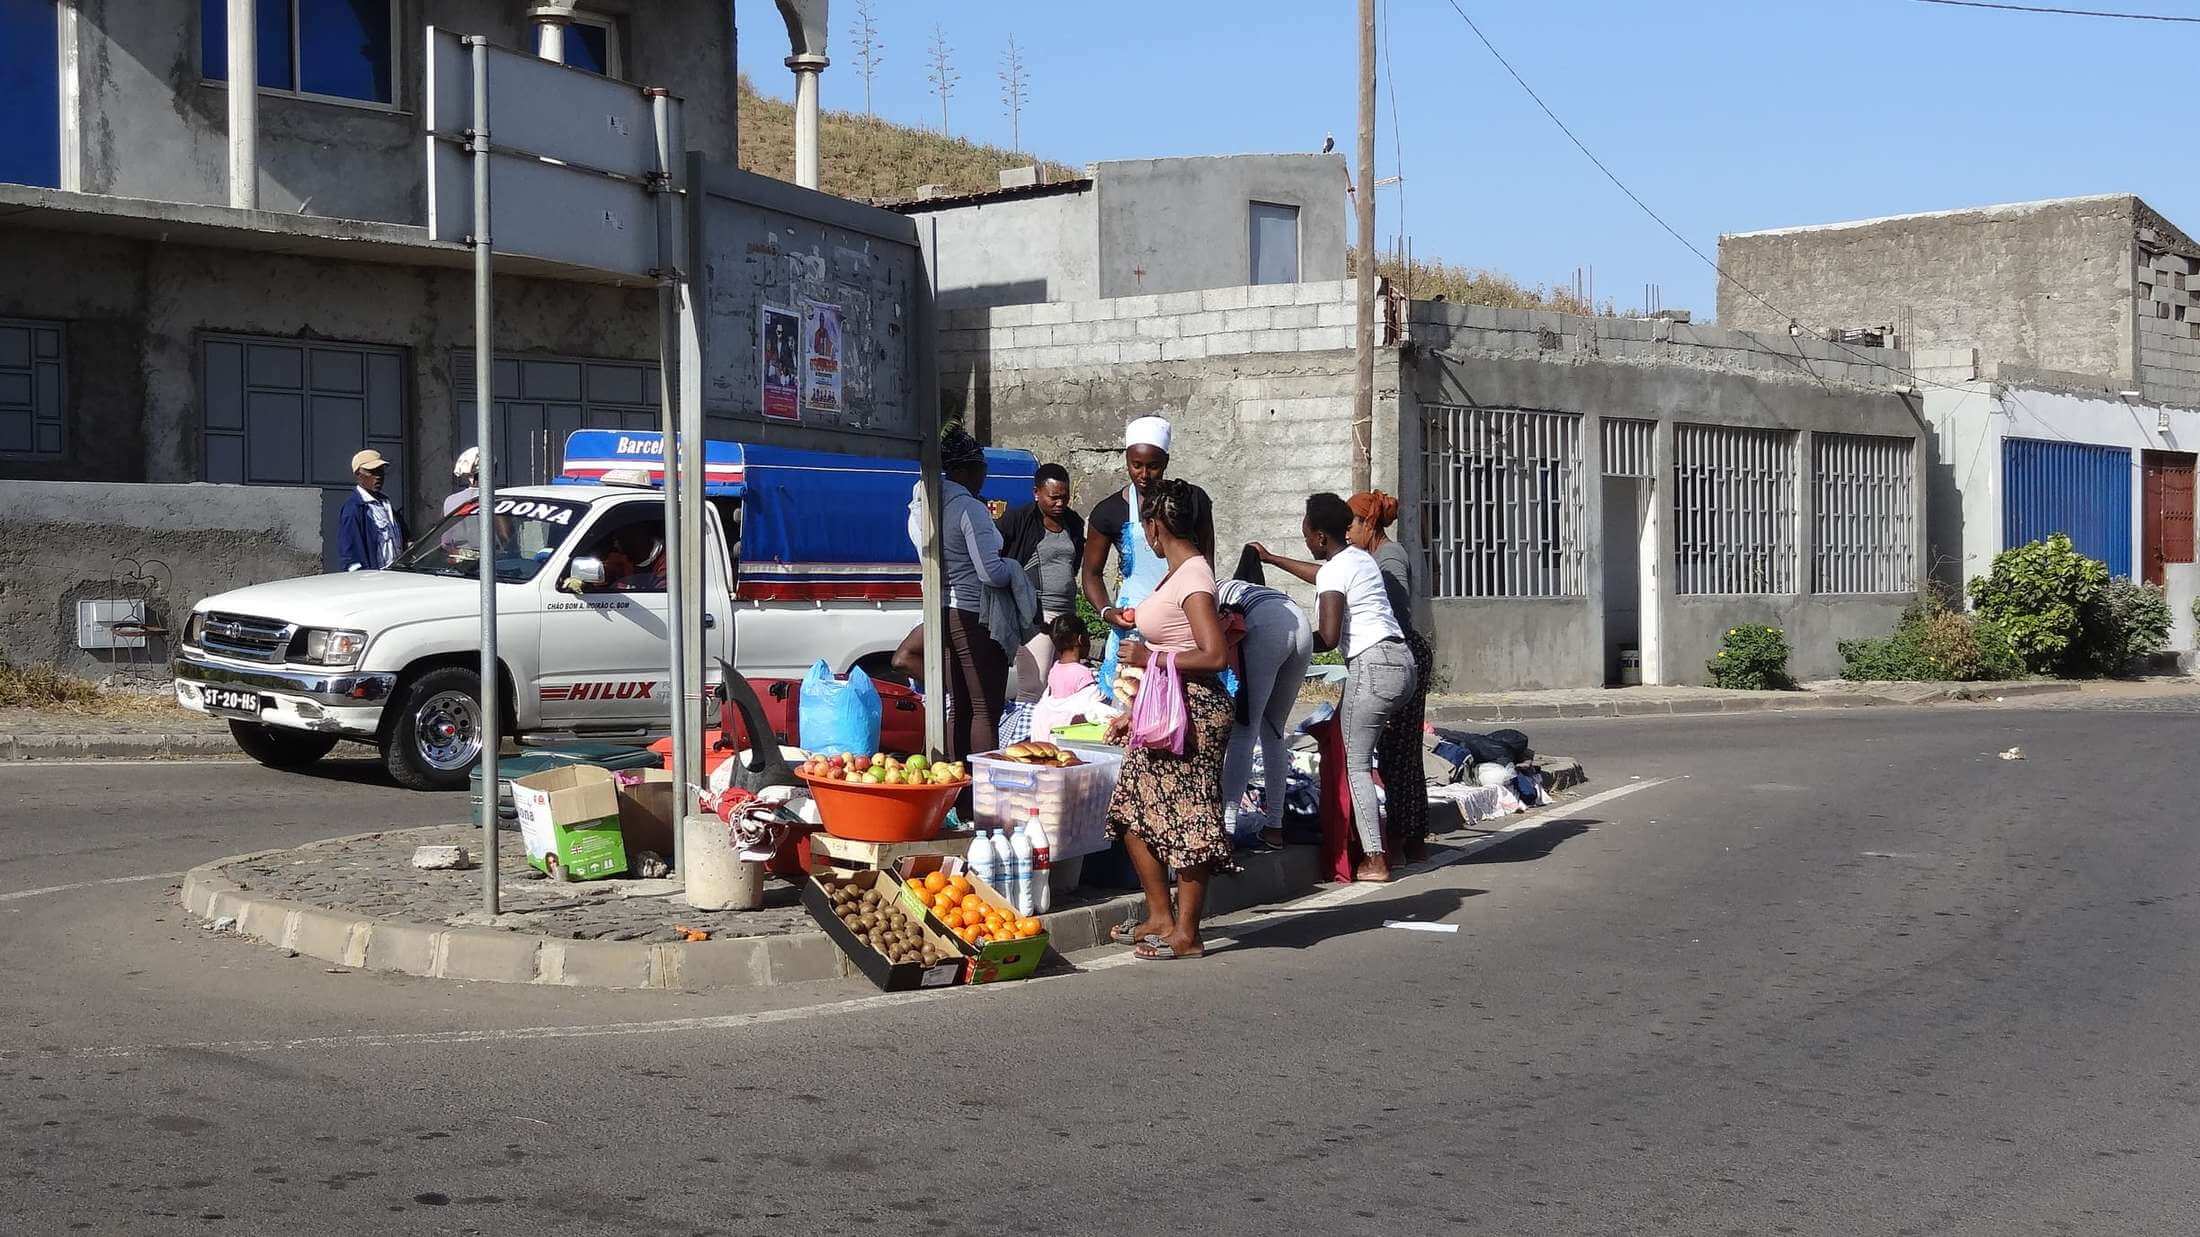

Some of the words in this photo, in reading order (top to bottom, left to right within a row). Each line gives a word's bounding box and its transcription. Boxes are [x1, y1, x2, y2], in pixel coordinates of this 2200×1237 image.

[616, 436, 682, 455] Barcel
[204, 688, 257, 711] ST-20-HS
[567, 681, 657, 700] HILUX
